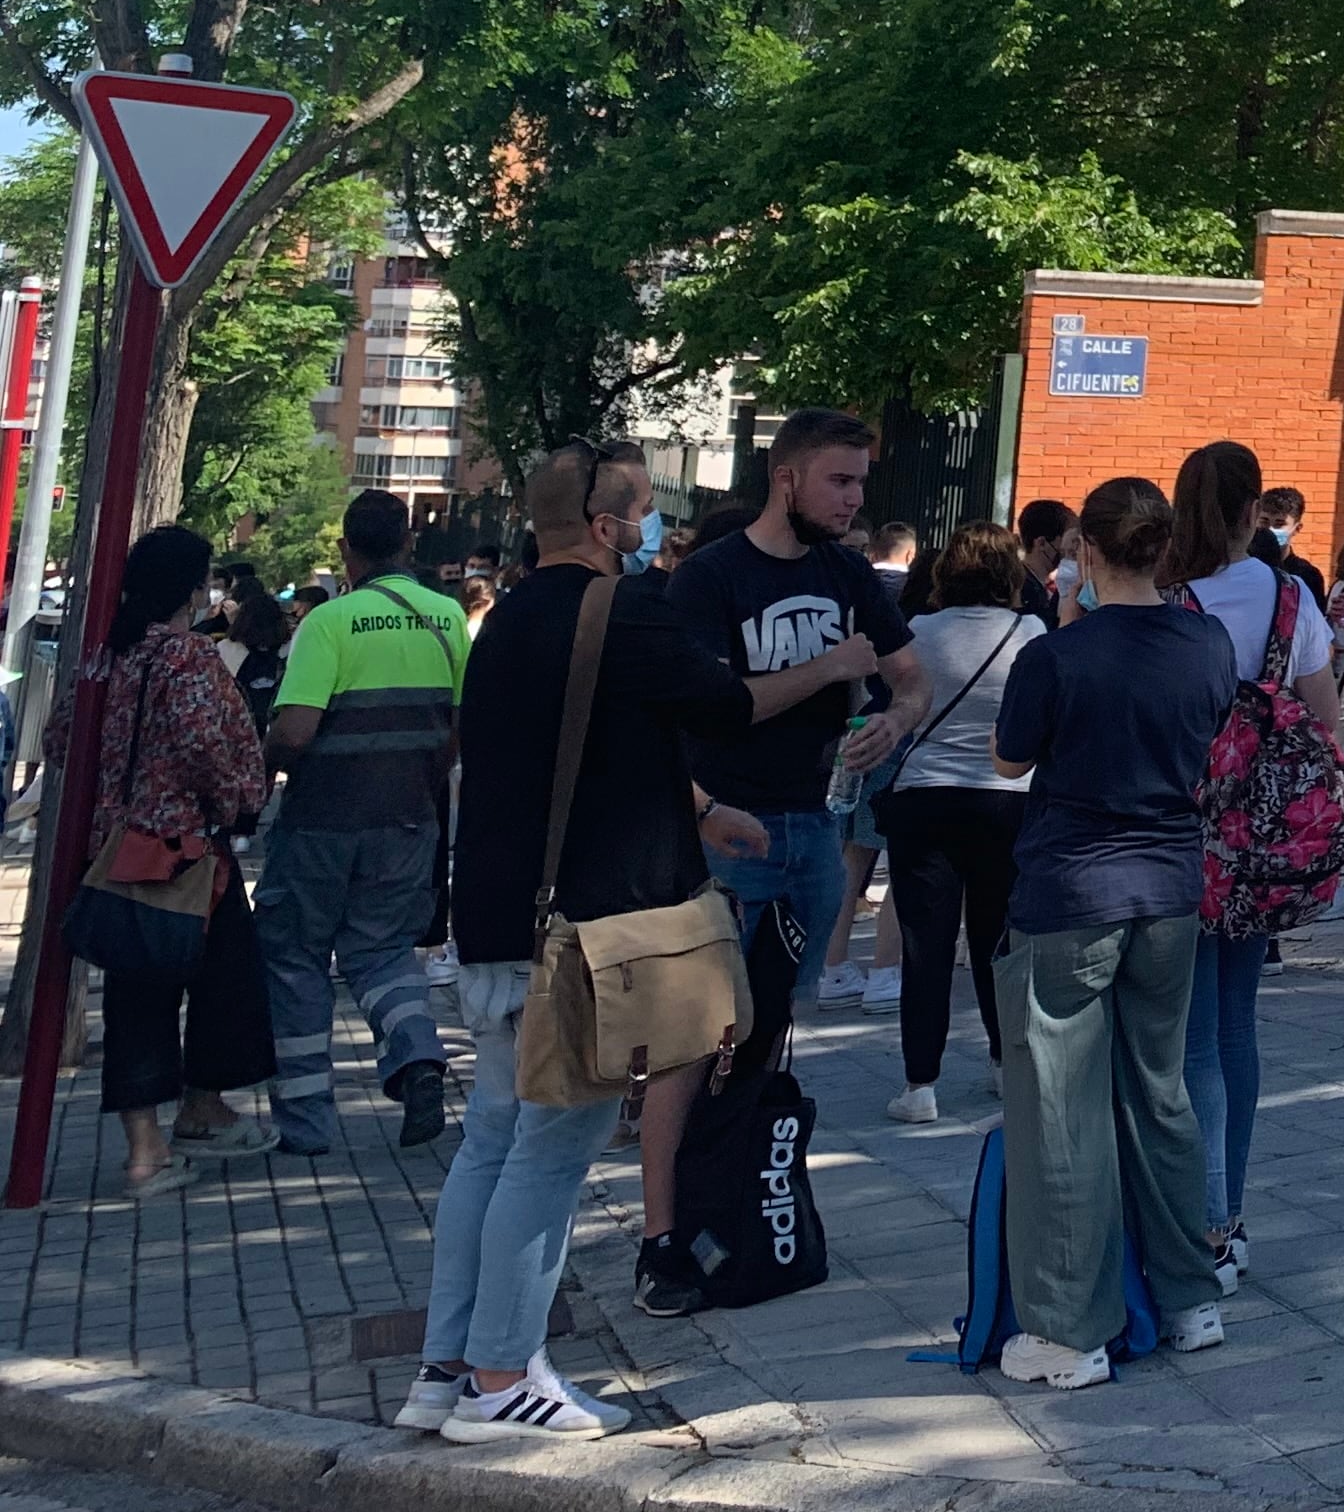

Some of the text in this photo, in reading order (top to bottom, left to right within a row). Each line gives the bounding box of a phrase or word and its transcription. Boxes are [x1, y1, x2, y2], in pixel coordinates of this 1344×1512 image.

[1061, 318, 1077, 331] 28
[1082, 340, 1132, 355] CALLE
[1056, 373, 1139, 393] CIFUENTES
[351, 615, 402, 634] ÁRIDOS
[741, 594, 845, 671] VANS
[760, 1116, 798, 1264] adidas
